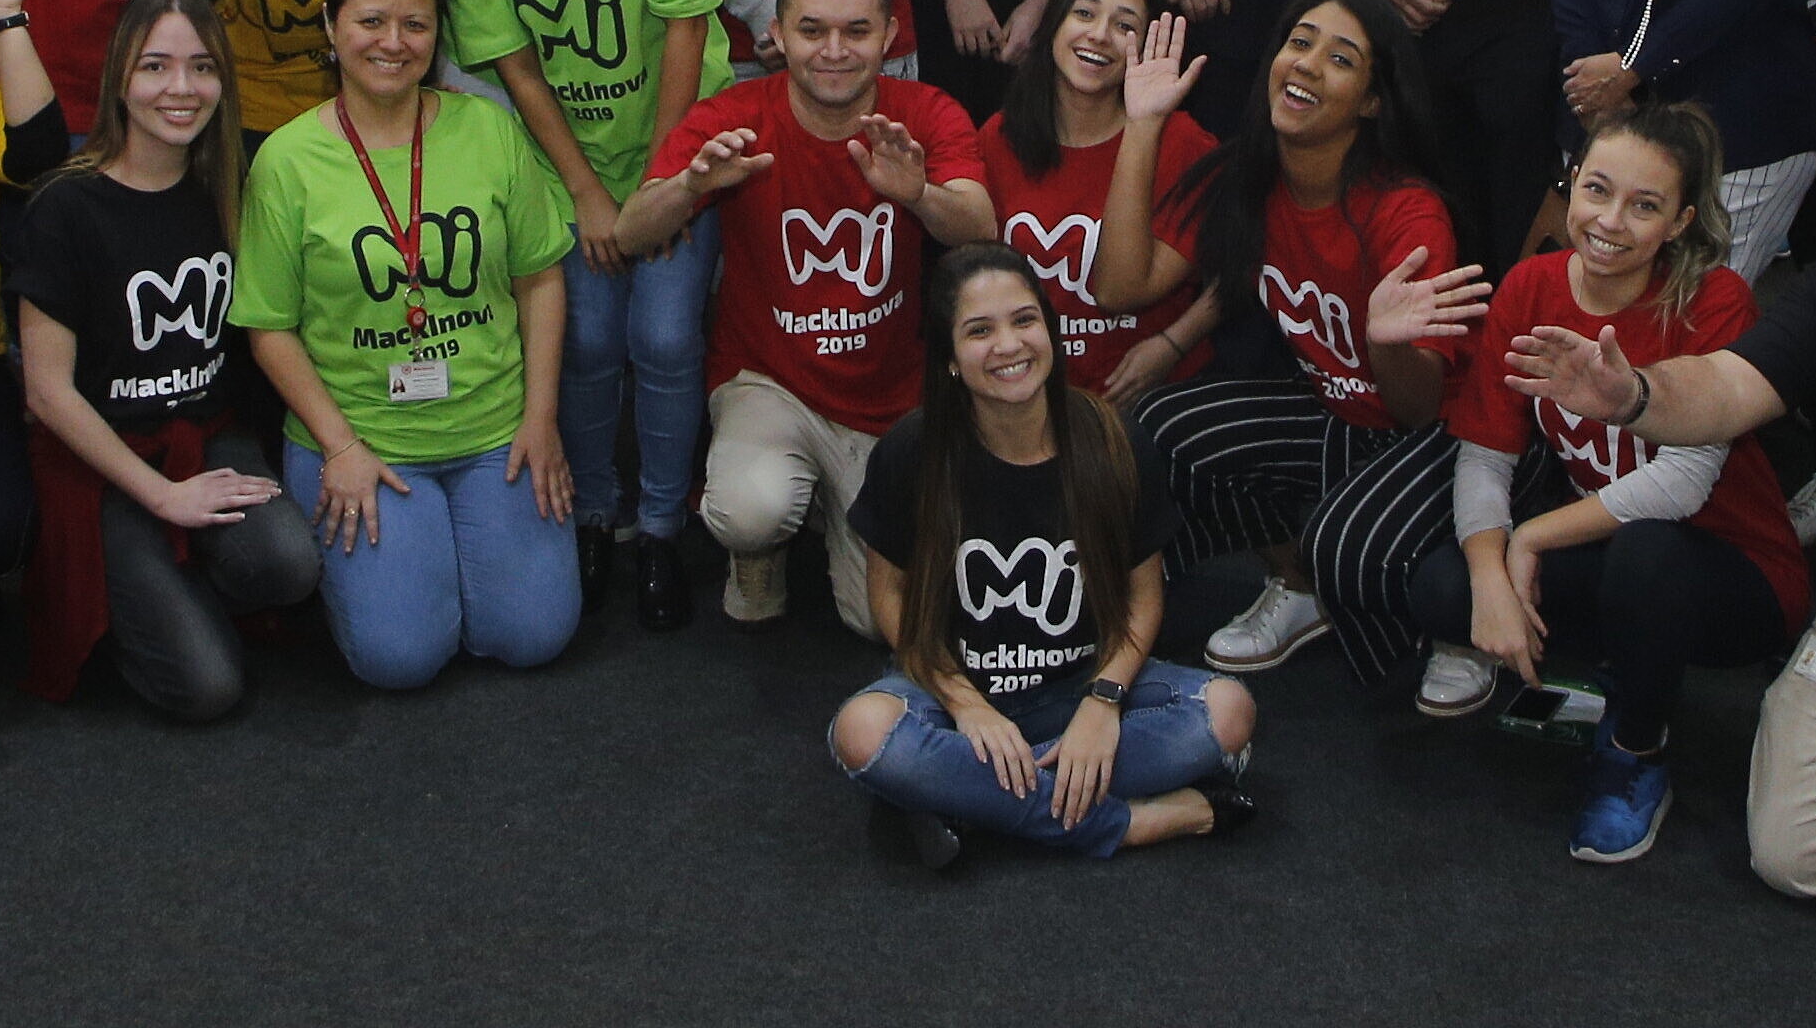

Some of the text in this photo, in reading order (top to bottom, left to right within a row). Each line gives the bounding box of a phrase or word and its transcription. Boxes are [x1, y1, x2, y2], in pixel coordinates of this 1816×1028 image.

[575, 106, 615, 122] 2019
[409, 338, 460, 362] 019
[816, 333, 866, 355] 2019
